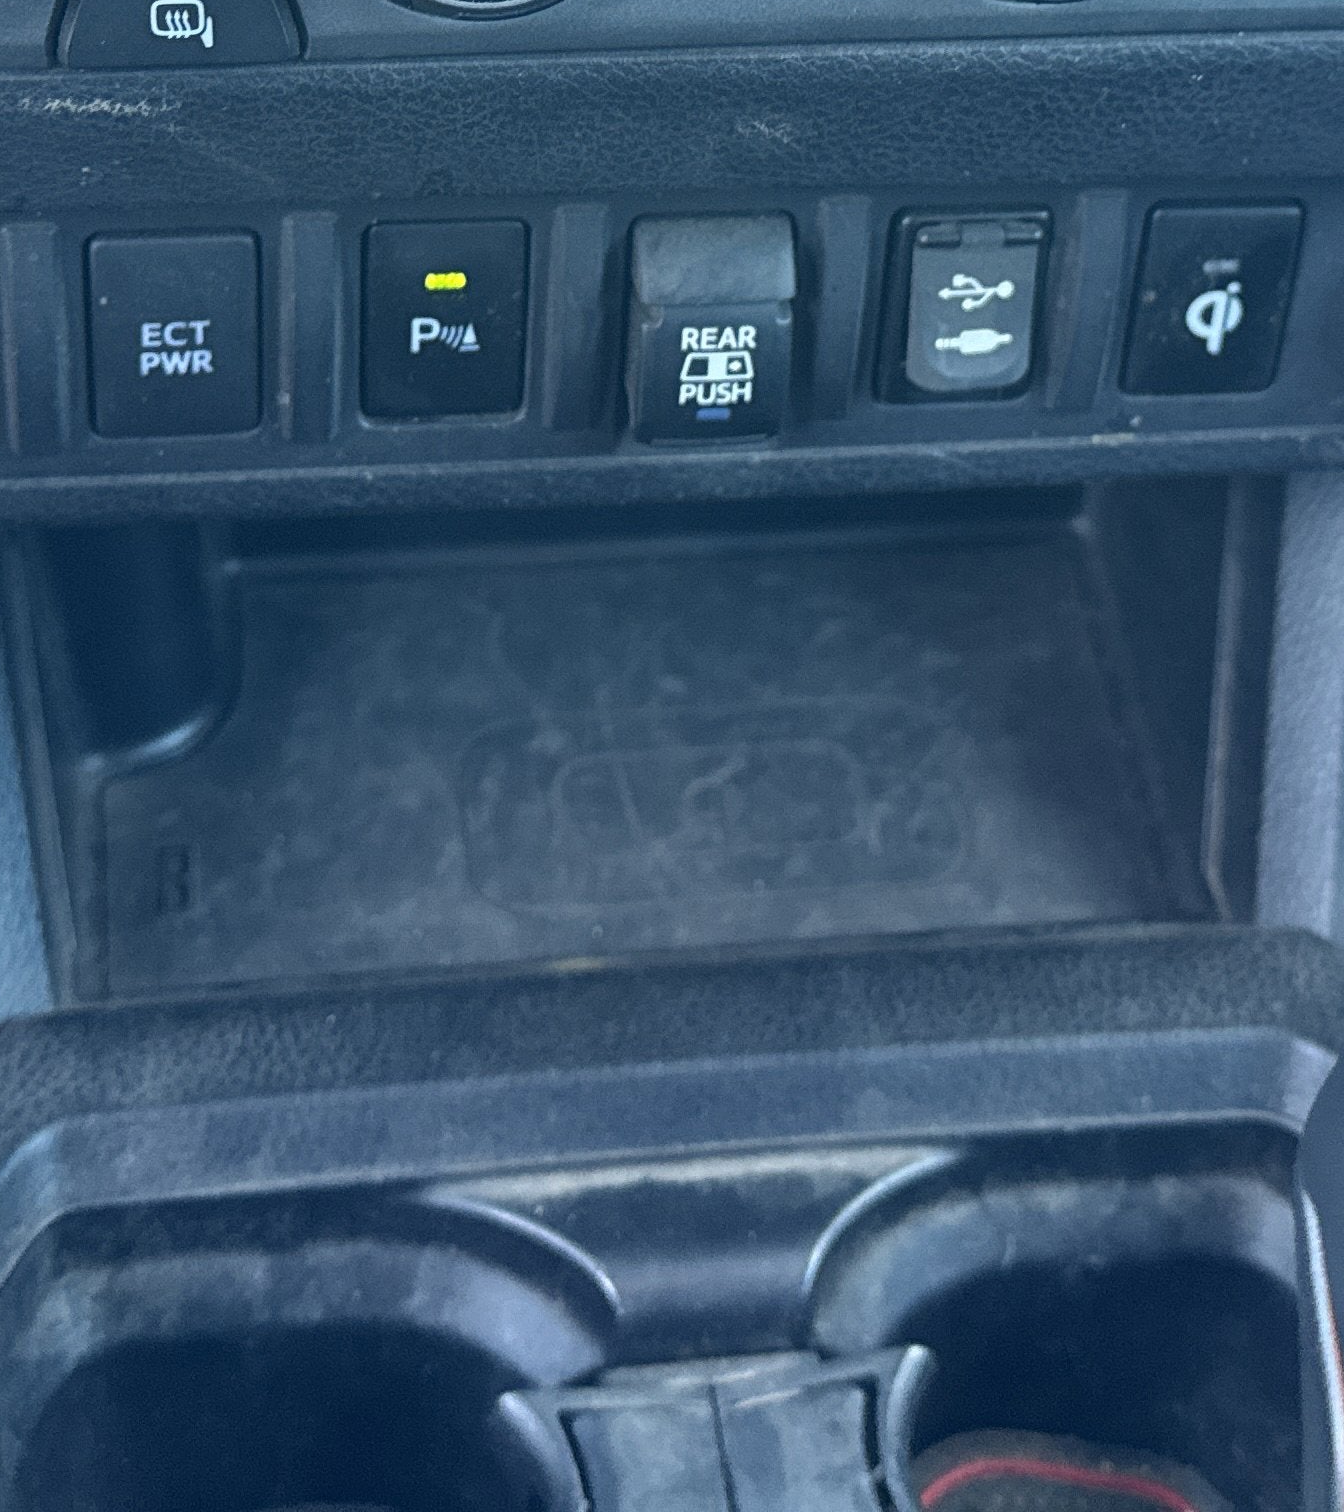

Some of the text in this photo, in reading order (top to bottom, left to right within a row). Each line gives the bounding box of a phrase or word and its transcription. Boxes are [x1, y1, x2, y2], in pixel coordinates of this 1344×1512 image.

[139, 320, 212, 349] ECT
[680, 324, 757, 352] REAR
[139, 350, 215, 377] PWR
[678, 380, 754, 407] PUSH
